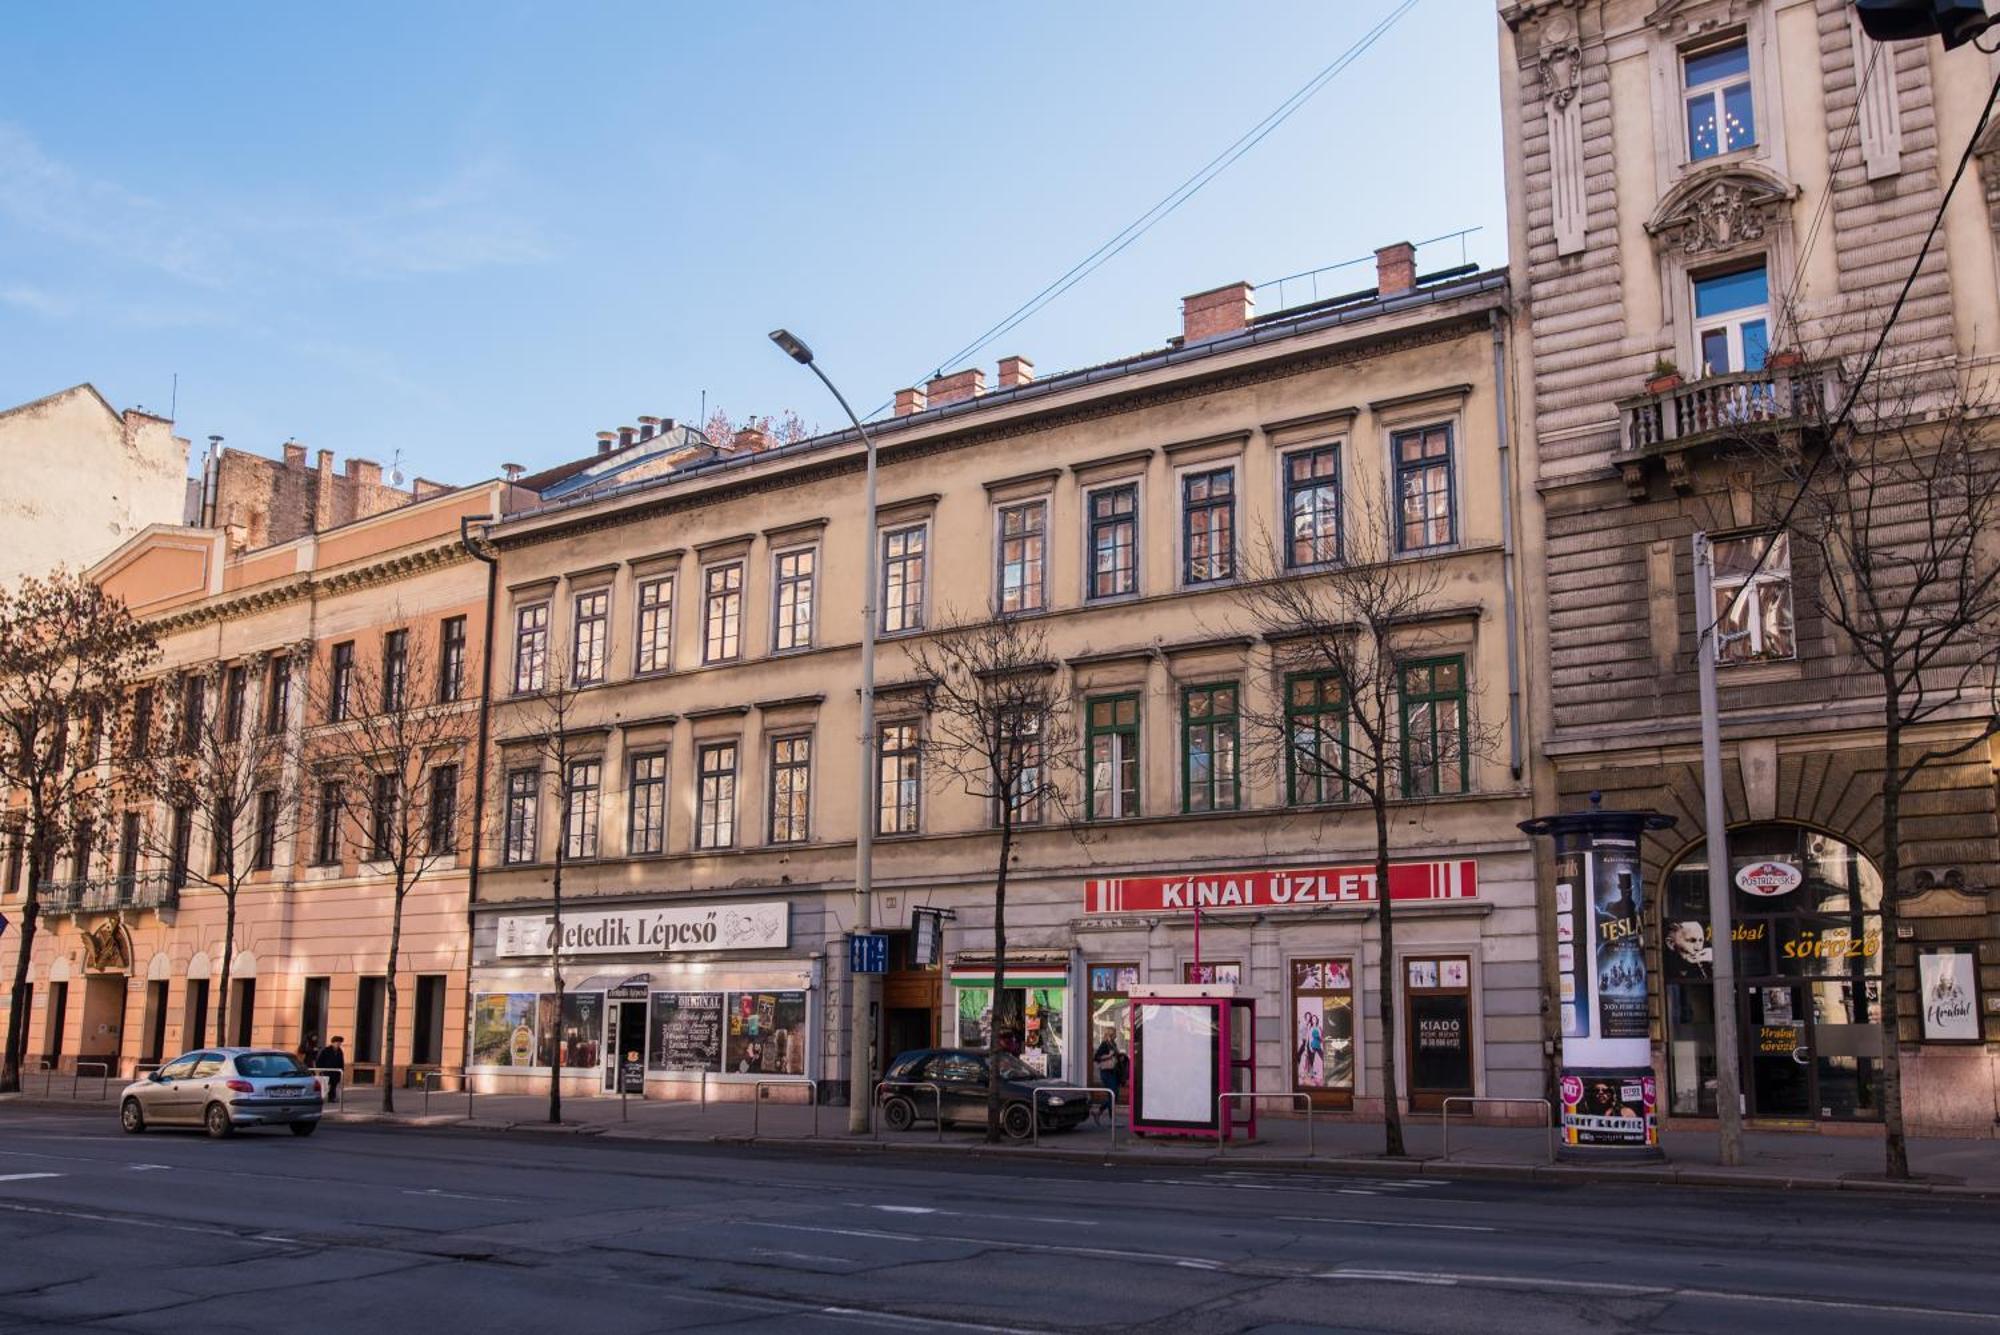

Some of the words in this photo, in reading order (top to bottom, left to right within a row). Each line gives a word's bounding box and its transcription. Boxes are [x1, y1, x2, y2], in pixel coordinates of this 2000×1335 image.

[1162, 876, 1252, 908] KÍNAI
[1270, 873, 1379, 903] ÜZLET
[638, 911, 717, 950] Lépcső
[1420, 1018, 1460, 1030] KIADÓ
